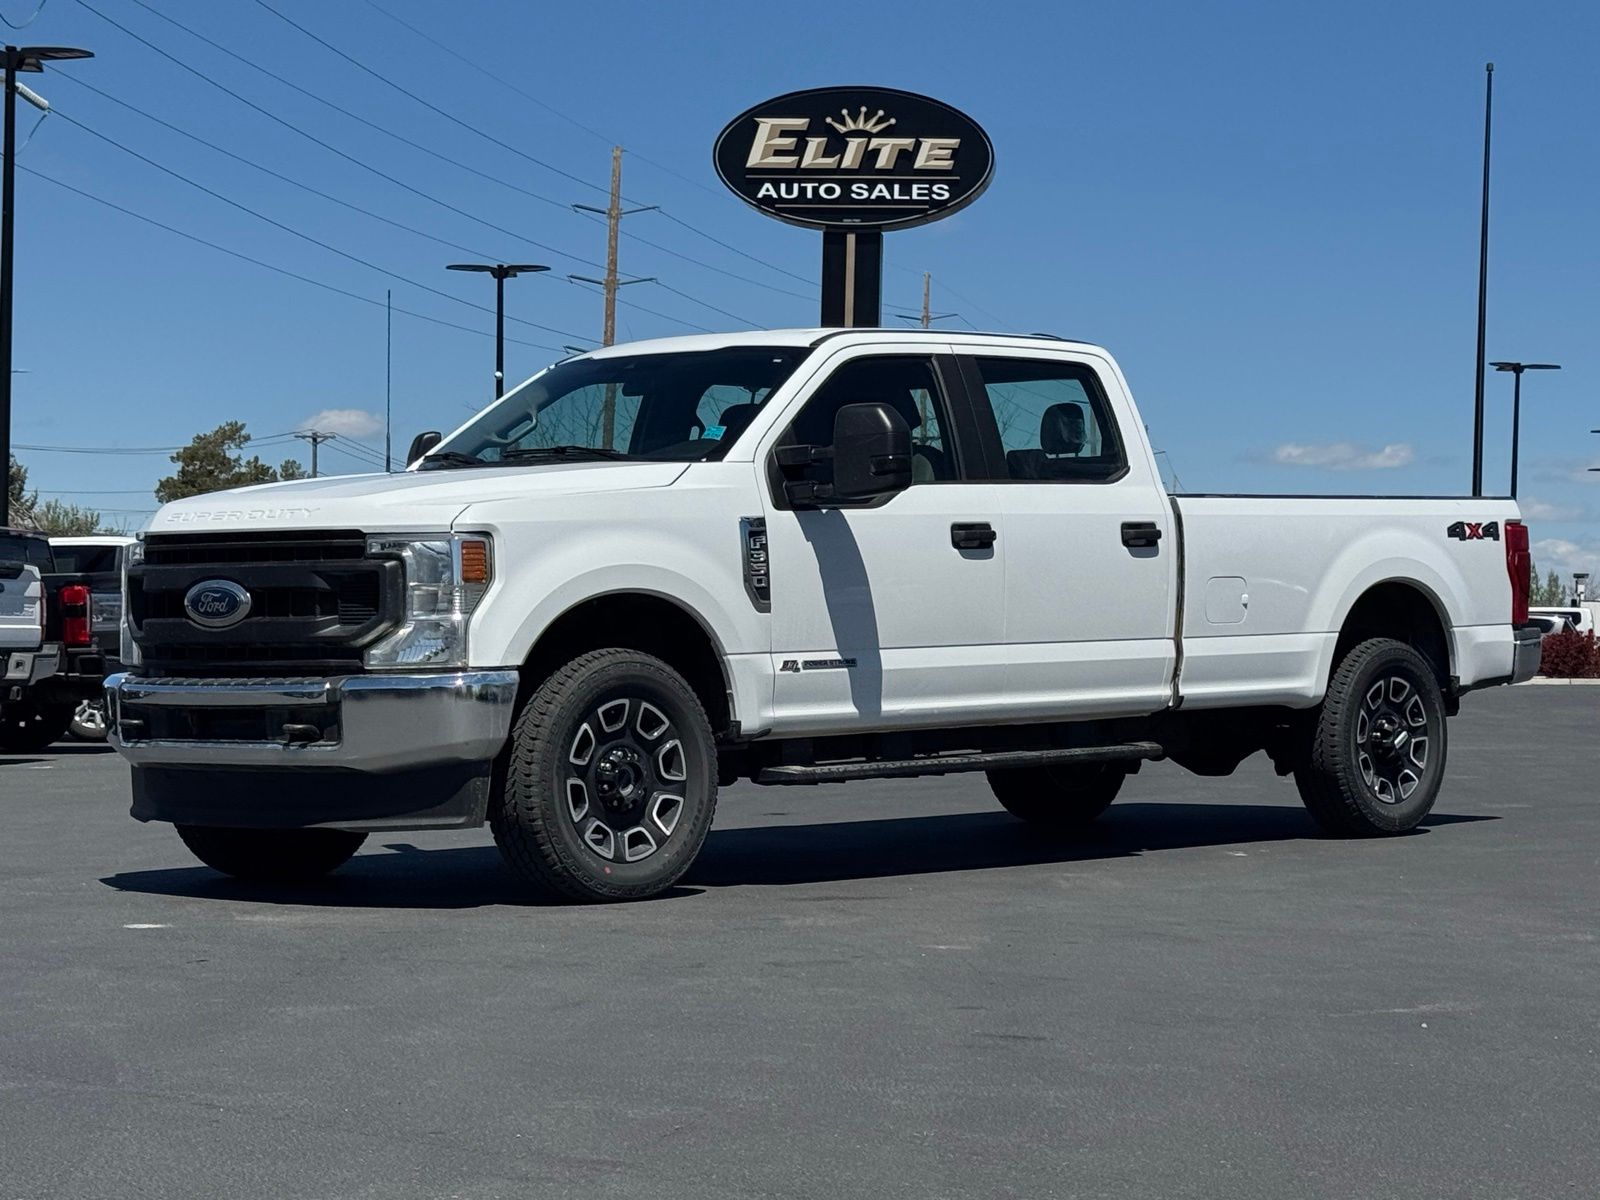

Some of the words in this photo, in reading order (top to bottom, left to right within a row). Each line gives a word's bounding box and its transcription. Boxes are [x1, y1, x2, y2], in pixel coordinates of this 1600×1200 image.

[745, 117, 961, 169] ELITE
[756, 182, 842, 199] AUTO
[850, 183, 950, 200] SALES
[167, 510, 243, 523] SUPER
[245, 506, 321, 521] DUTY
[198, 592, 229, 612] Ford
